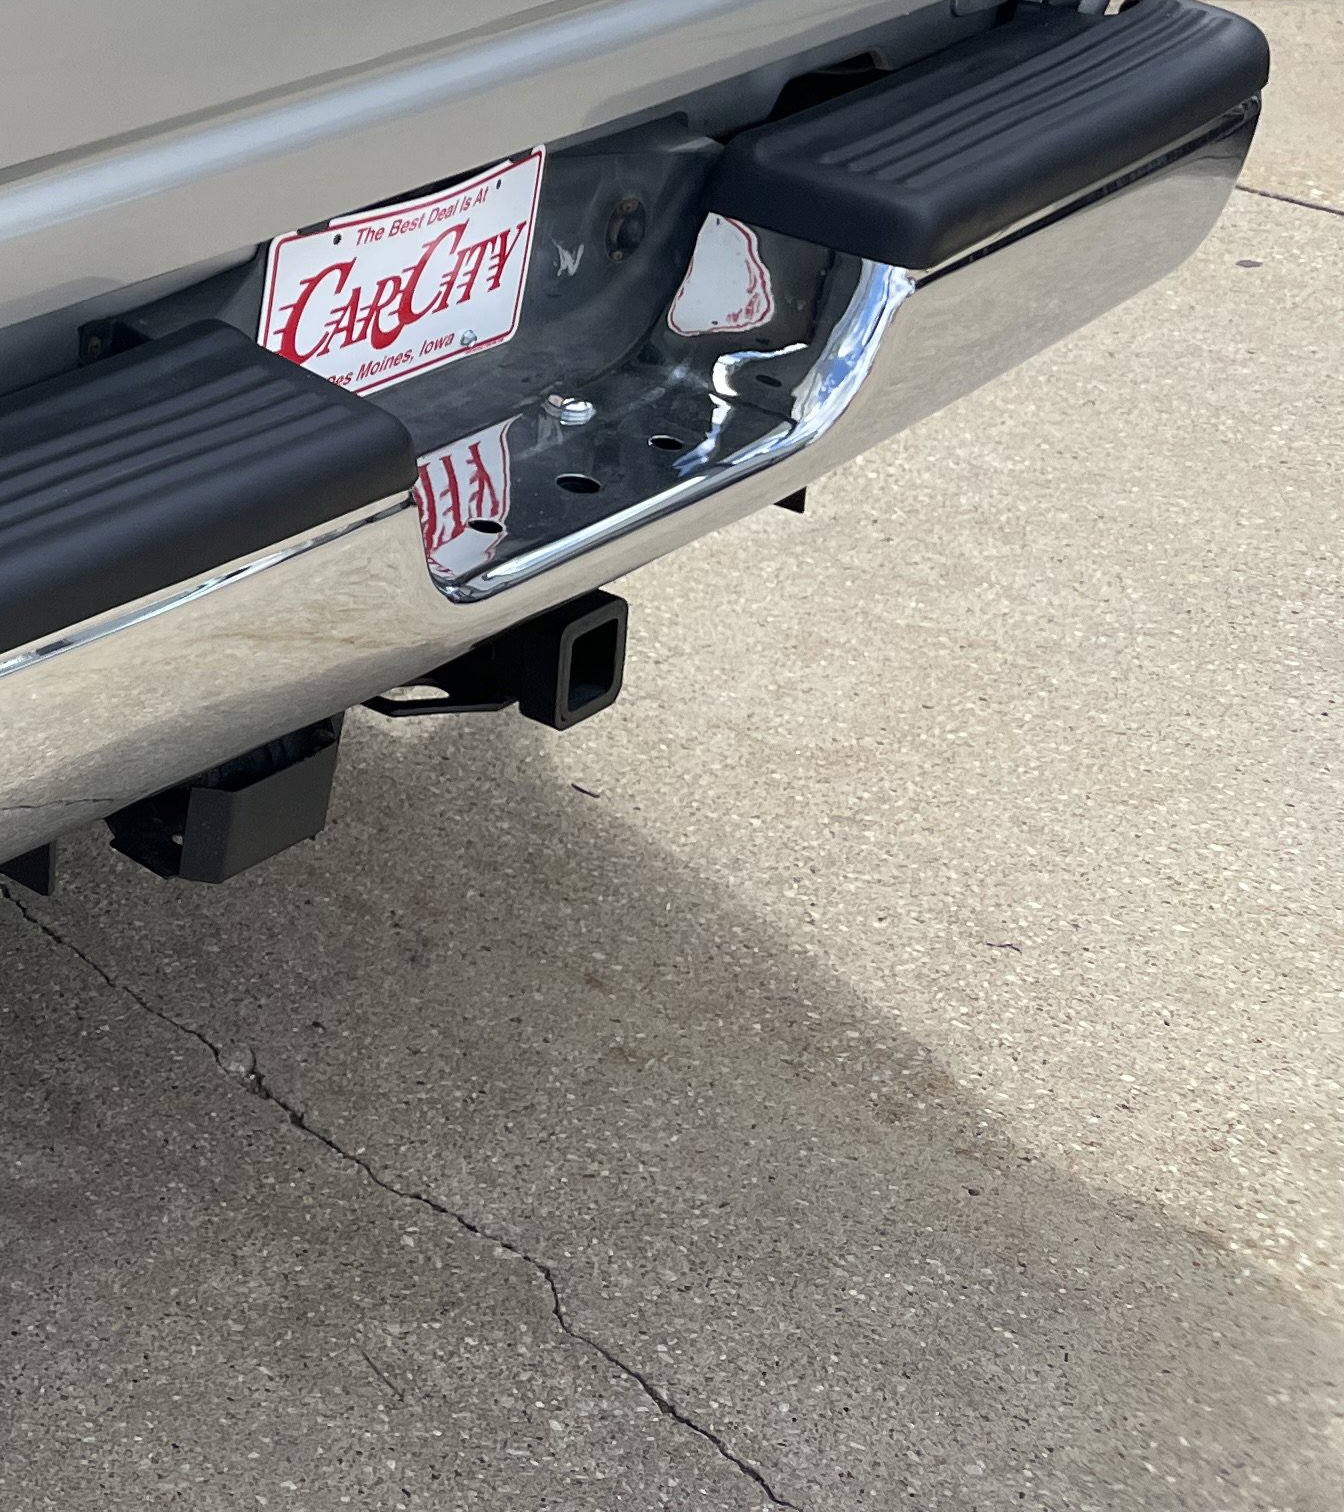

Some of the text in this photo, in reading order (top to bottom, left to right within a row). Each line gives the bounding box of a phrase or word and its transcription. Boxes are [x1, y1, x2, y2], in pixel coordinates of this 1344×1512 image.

[356, 186, 489, 246] The Best Deal Is At
[356, 349, 414, 381] Moines,
[419, 332, 455, 357] Iowa
